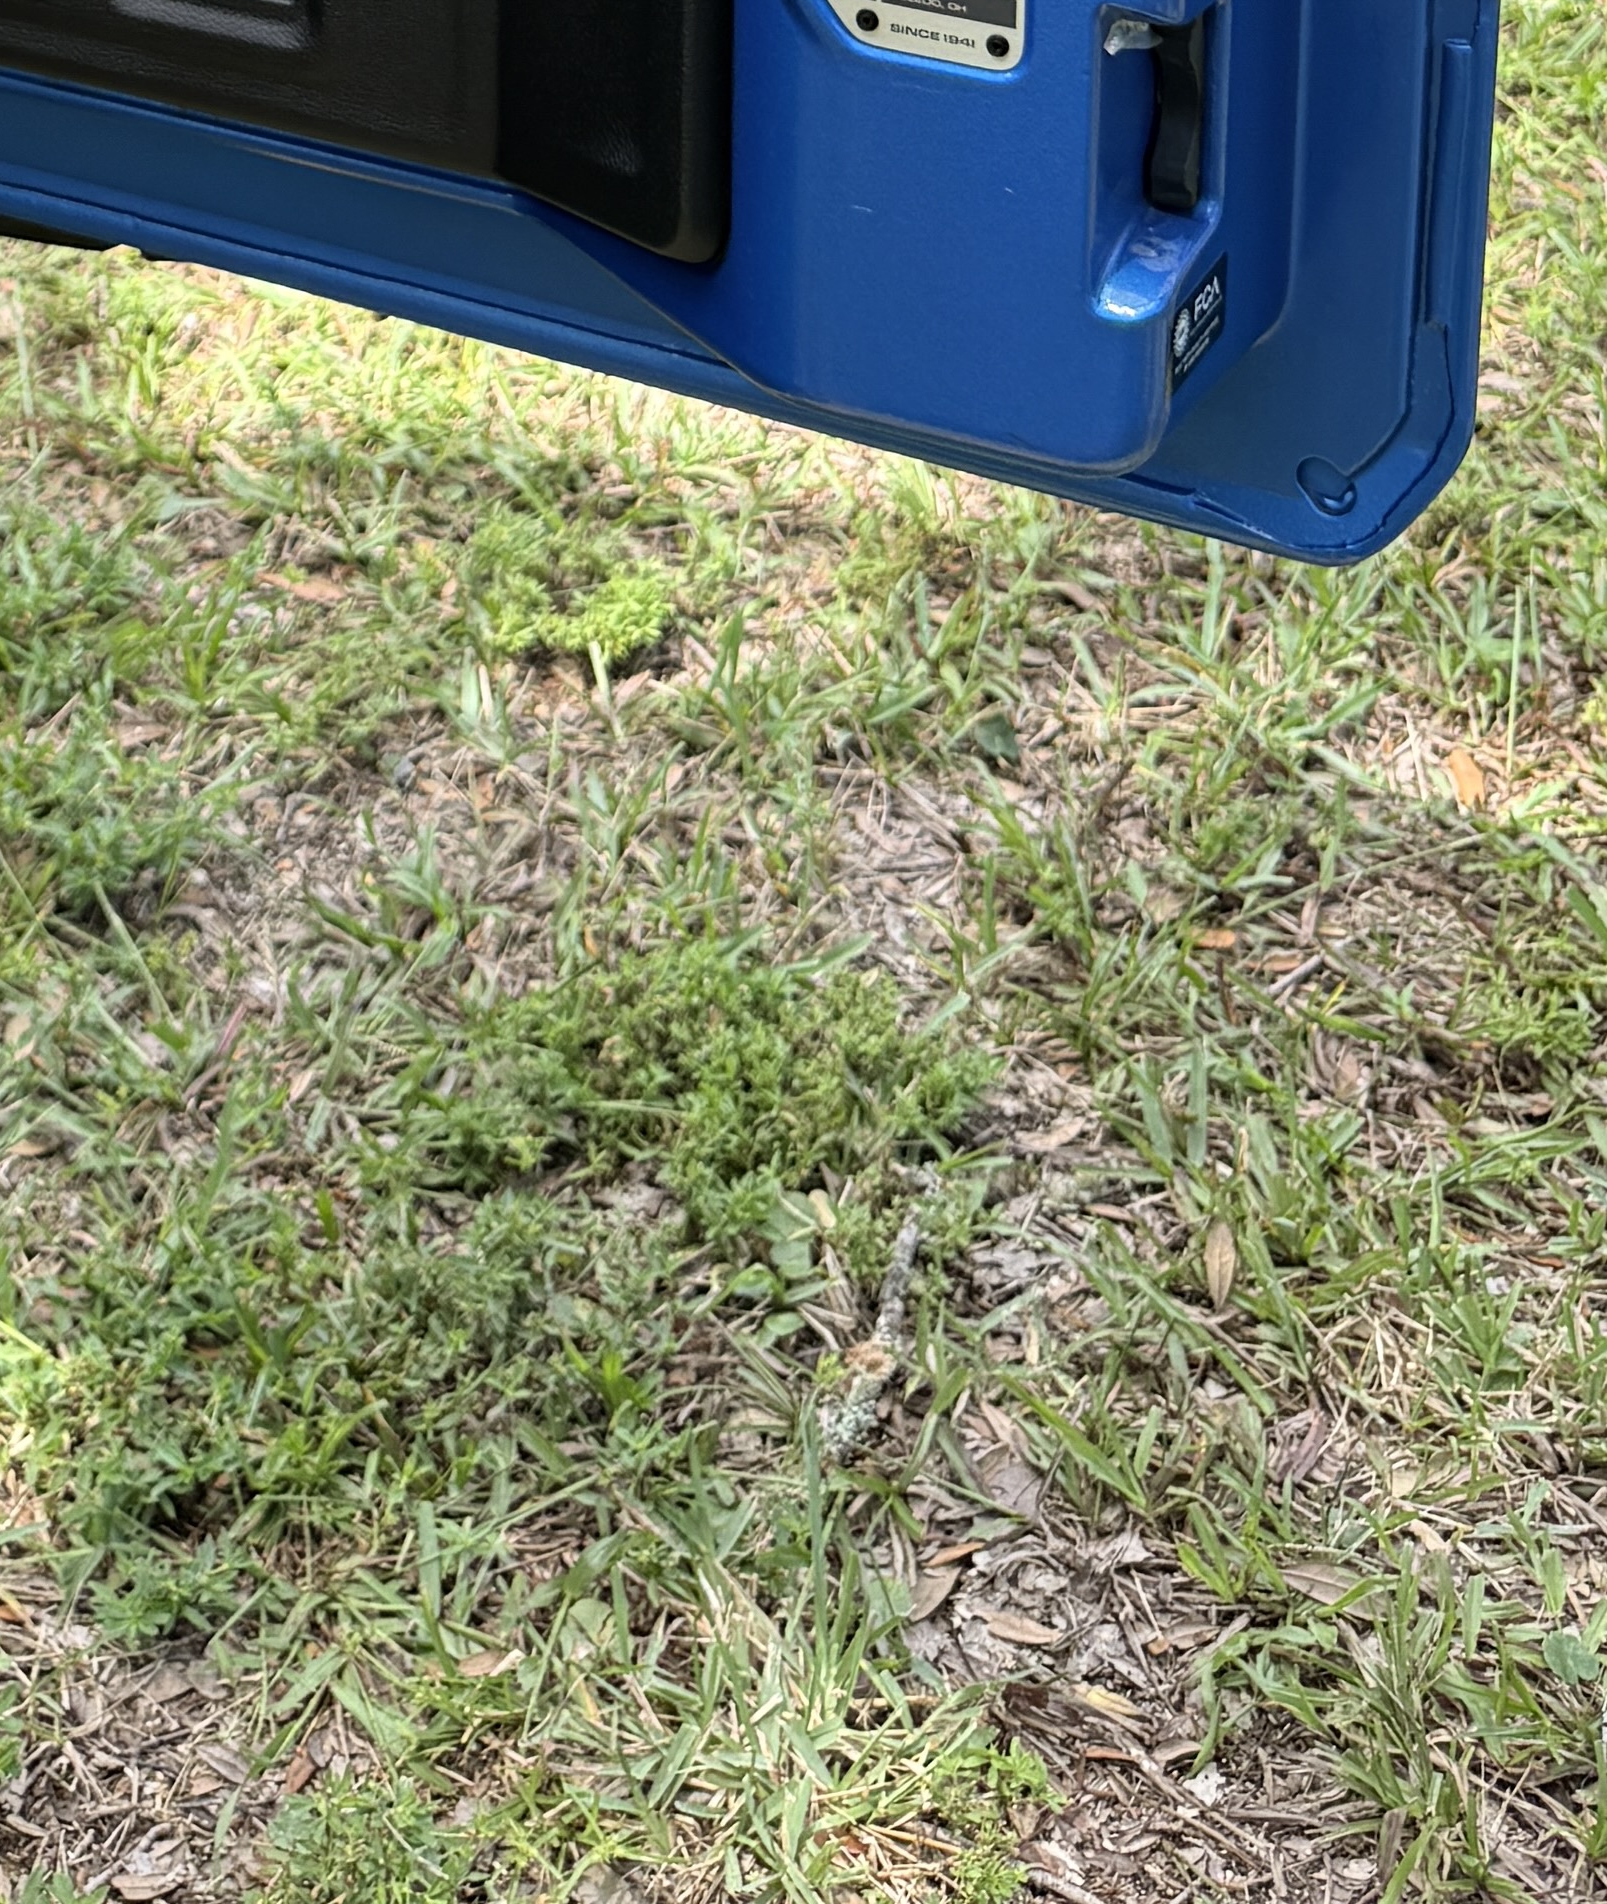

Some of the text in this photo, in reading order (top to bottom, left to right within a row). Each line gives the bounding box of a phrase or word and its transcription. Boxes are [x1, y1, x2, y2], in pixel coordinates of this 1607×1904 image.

[947, 2, 967, 13] OH
[889, 22, 976, 48] SINCE 1941
